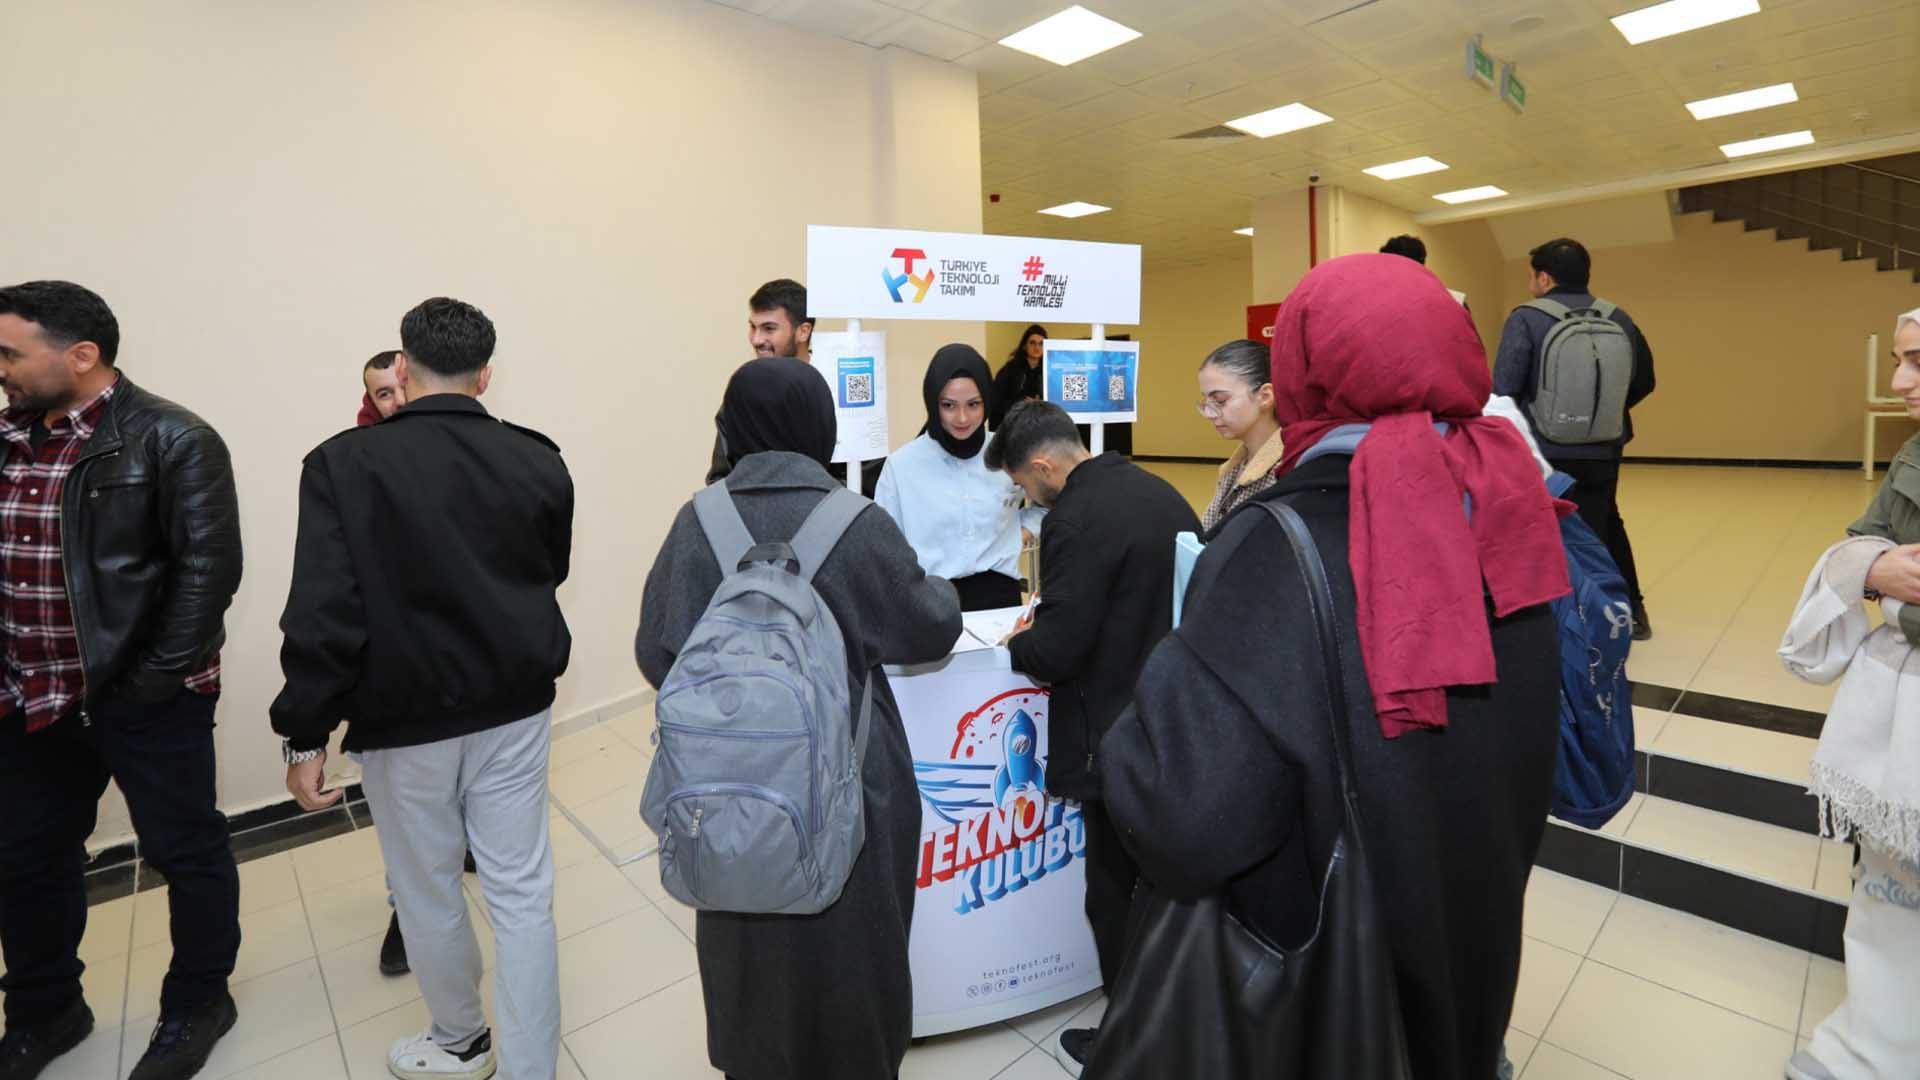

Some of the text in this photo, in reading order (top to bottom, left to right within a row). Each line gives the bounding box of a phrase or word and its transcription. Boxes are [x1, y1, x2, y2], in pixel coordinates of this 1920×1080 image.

[940, 260, 987, 273] TÜRKİYE
[940, 272, 999, 285] TEKNOLOJİ
[940, 284, 975, 297] TAKIMI
[1016, 284, 1066, 297] TEKNOLOJİ
[982, 952, 1061, 979] teknofest.org
[1022, 960, 1076, 983] teknofest
